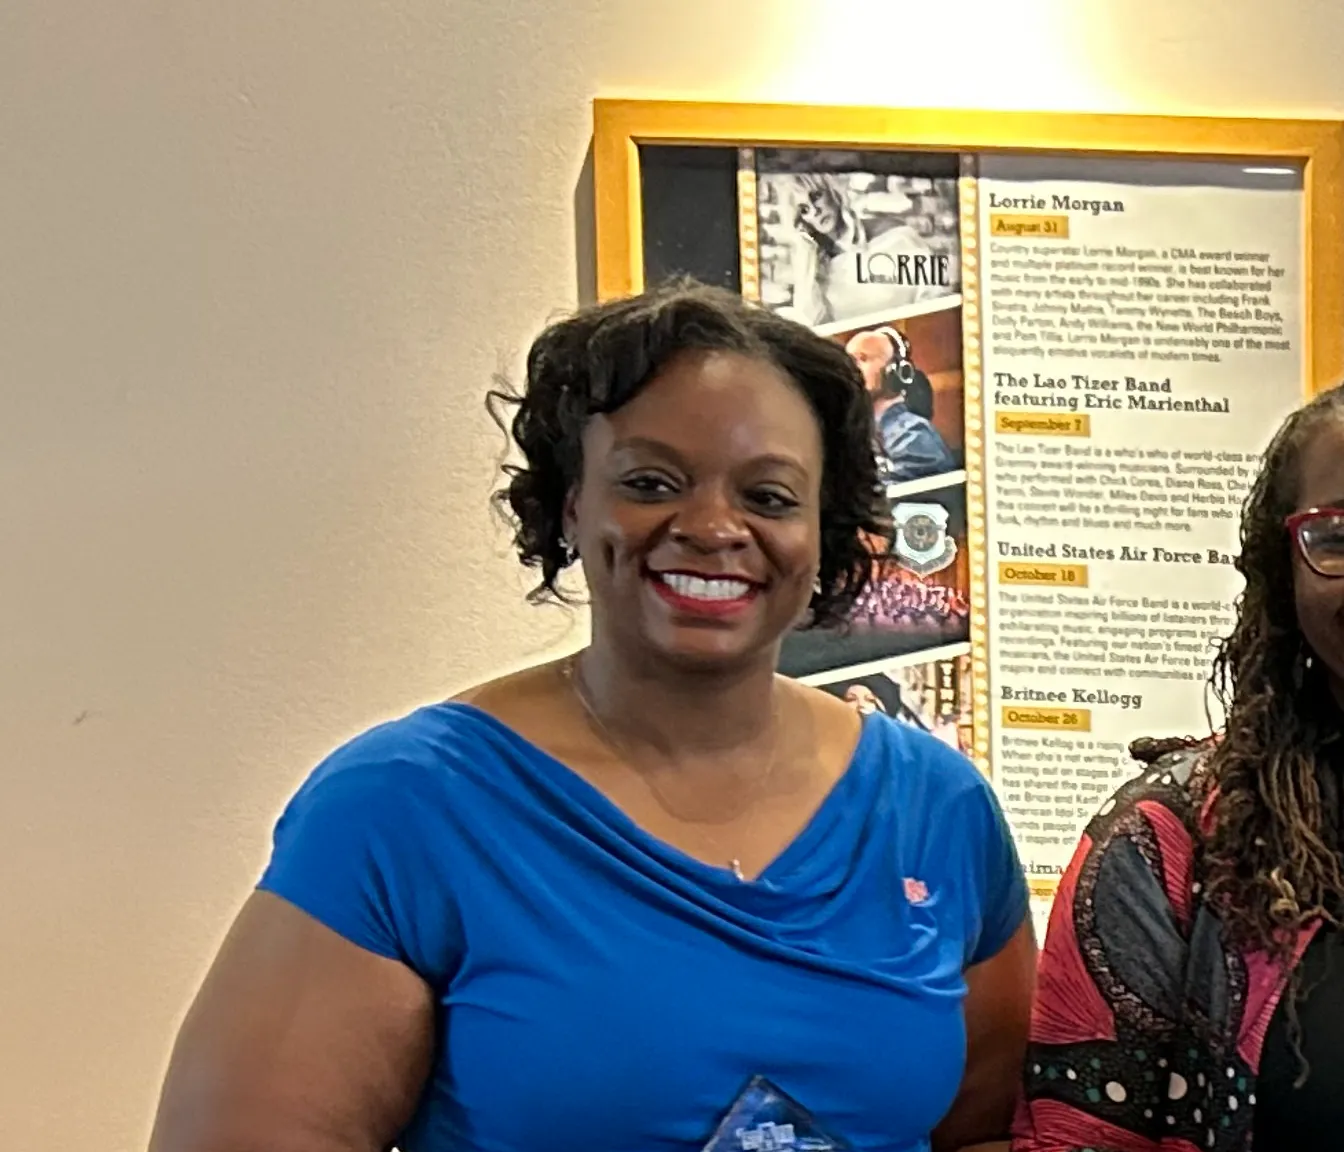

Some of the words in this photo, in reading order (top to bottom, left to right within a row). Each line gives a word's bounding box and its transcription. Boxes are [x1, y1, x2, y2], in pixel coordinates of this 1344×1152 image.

[989, 192, 1046, 210] Lorrie
[1052, 194, 1124, 216] Morgan
[996, 219, 1041, 236] August
[1044, 221, 1058, 233] 31
[856, 252, 950, 286] LORRIE
[993, 371, 1028, 388] The
[1033, 372, 1067, 389] Lao
[1071, 375, 1119, 392] Tizer
[1124, 376, 1172, 393] Band
[995, 390, 1079, 413] featuring
[1084, 393, 1122, 410] Eric
[1128, 394, 1230, 413] Marienthal
[1001, 416, 1072, 432] September
[997, 540, 1057, 558] United
[1062, 543, 1115, 561] States
[1120, 546, 1148, 562] Air
[1153, 547, 1202, 564] Force
[1206, 549, 1240, 564] Ba
[1004, 568, 1057, 582] October
[1061, 569, 1076, 582] 18
[1000, 685, 1067, 702] Britnee
[1072, 688, 1142, 710] Kellogg
[1008, 711, 1061, 725] October
